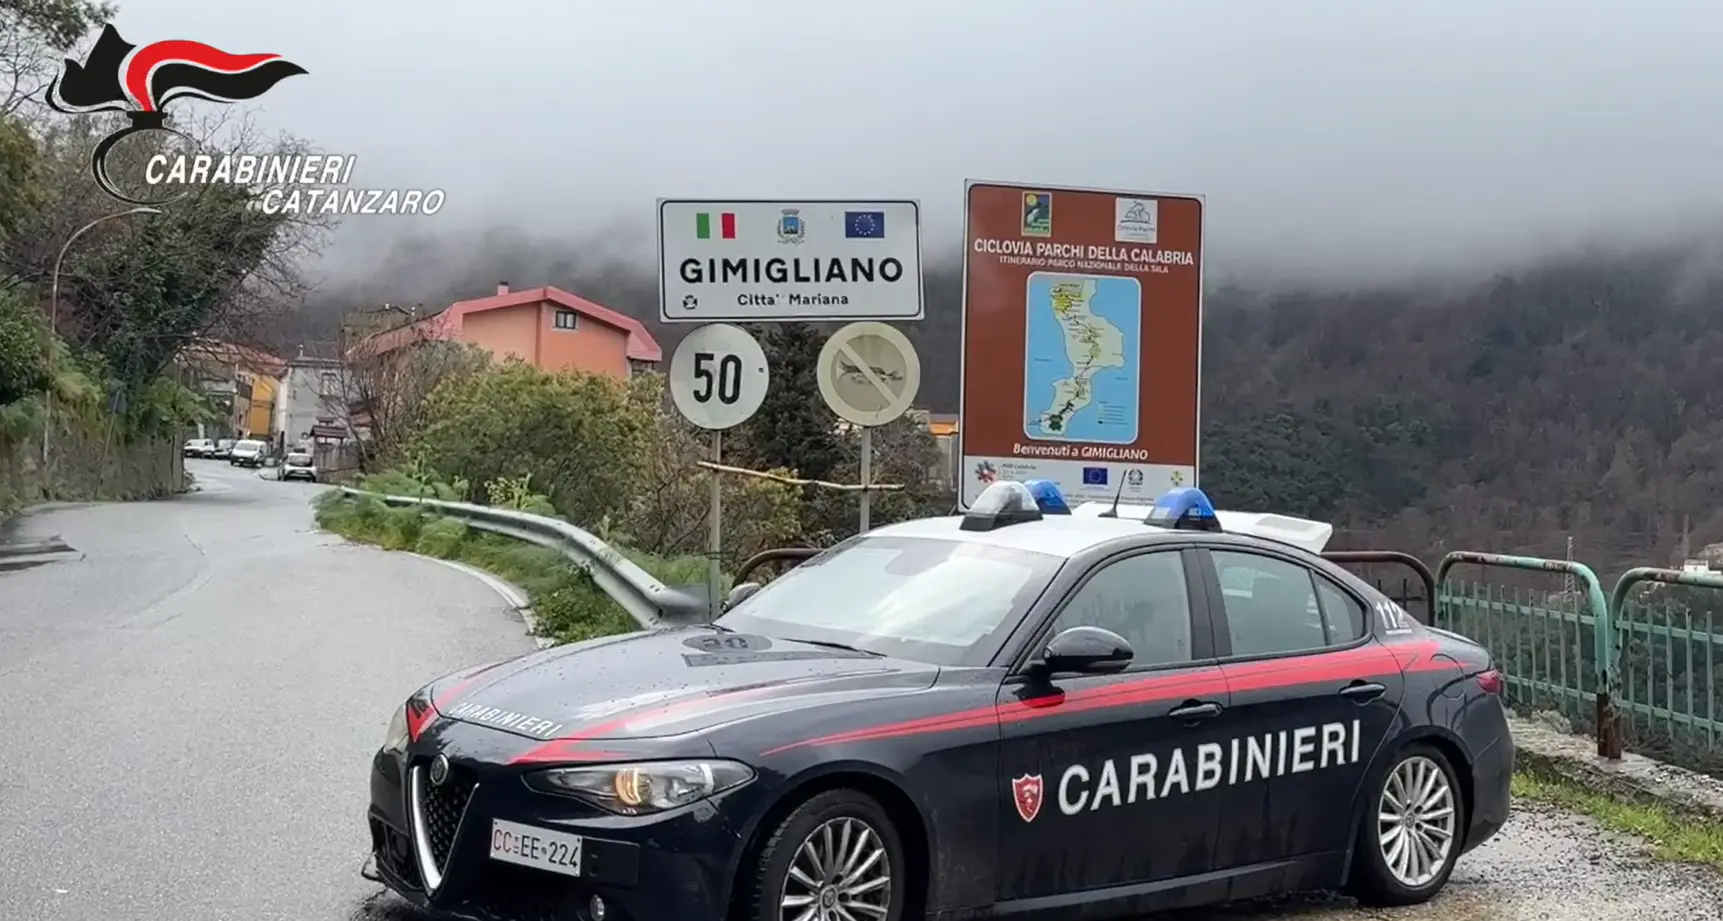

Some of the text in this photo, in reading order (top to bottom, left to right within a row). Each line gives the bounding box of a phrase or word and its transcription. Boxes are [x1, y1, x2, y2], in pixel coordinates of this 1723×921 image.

[974, 238, 1194, 266] CICLOVIA PARCHI DELLA CALABRIA
[999, 255, 1169, 274] ITINERARIO PARCO NAZIONALE DELLA SILA
[680, 257, 903, 284] GIMIGLIANO
[737, 293, 849, 306] Citta' Mariana
[693, 353, 742, 405] 50
[1013, 443, 1148, 461] Benvenuti a GIMIGLIANO
[1376, 601, 1409, 629] 112
[1057, 719, 1361, 815] CARABINIERI
